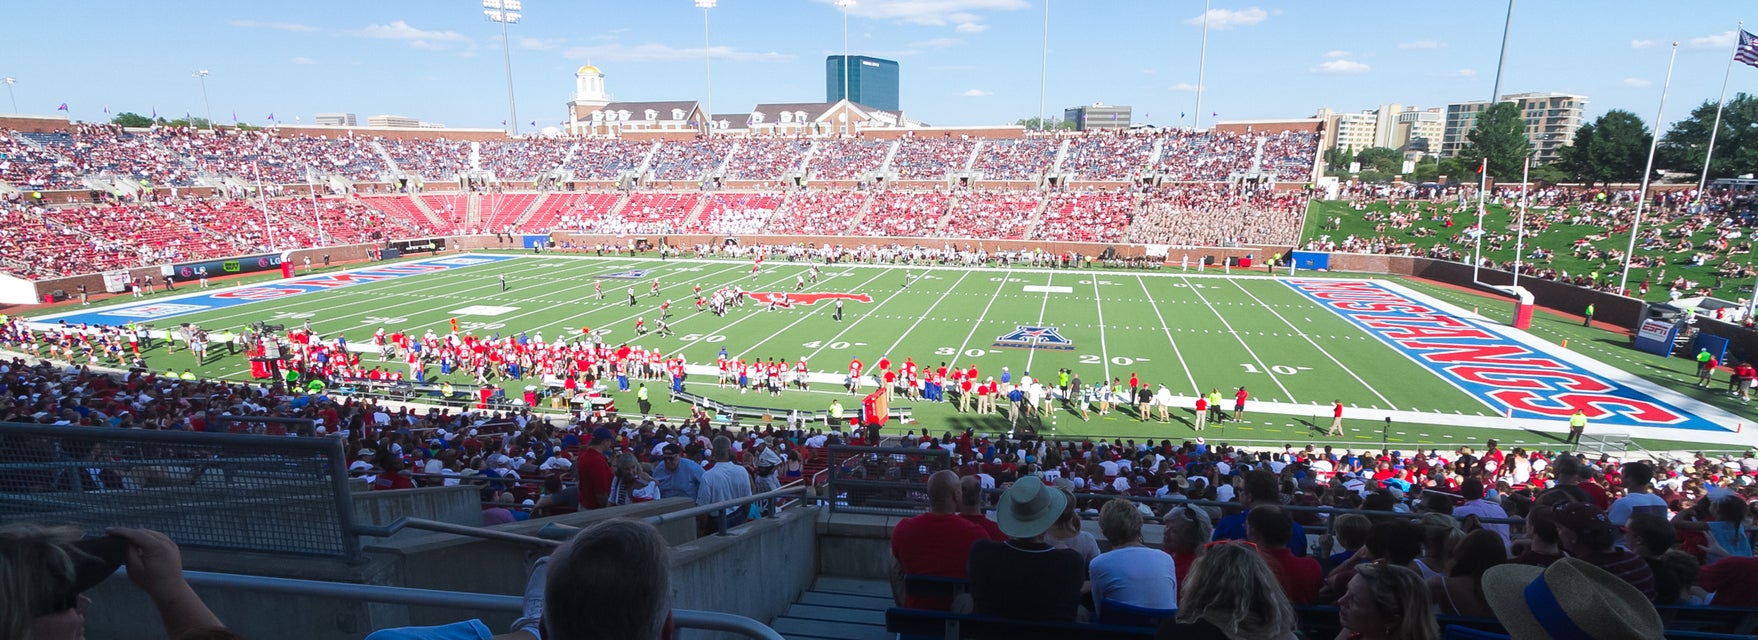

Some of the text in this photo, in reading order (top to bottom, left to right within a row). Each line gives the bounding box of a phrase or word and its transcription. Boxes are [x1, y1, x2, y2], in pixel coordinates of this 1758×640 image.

[270, 257, 281, 265] LG
[1642, 322, 1669, 335] ESPN
[679, 333, 727, 343] 50
[802, 340, 851, 350] 40
[933, 346, 985, 357] 30
[1287, 279, 1691, 425] MUSTANGS
[1079, 354, 1134, 366] 20
[1239, 363, 1298, 375] 10
